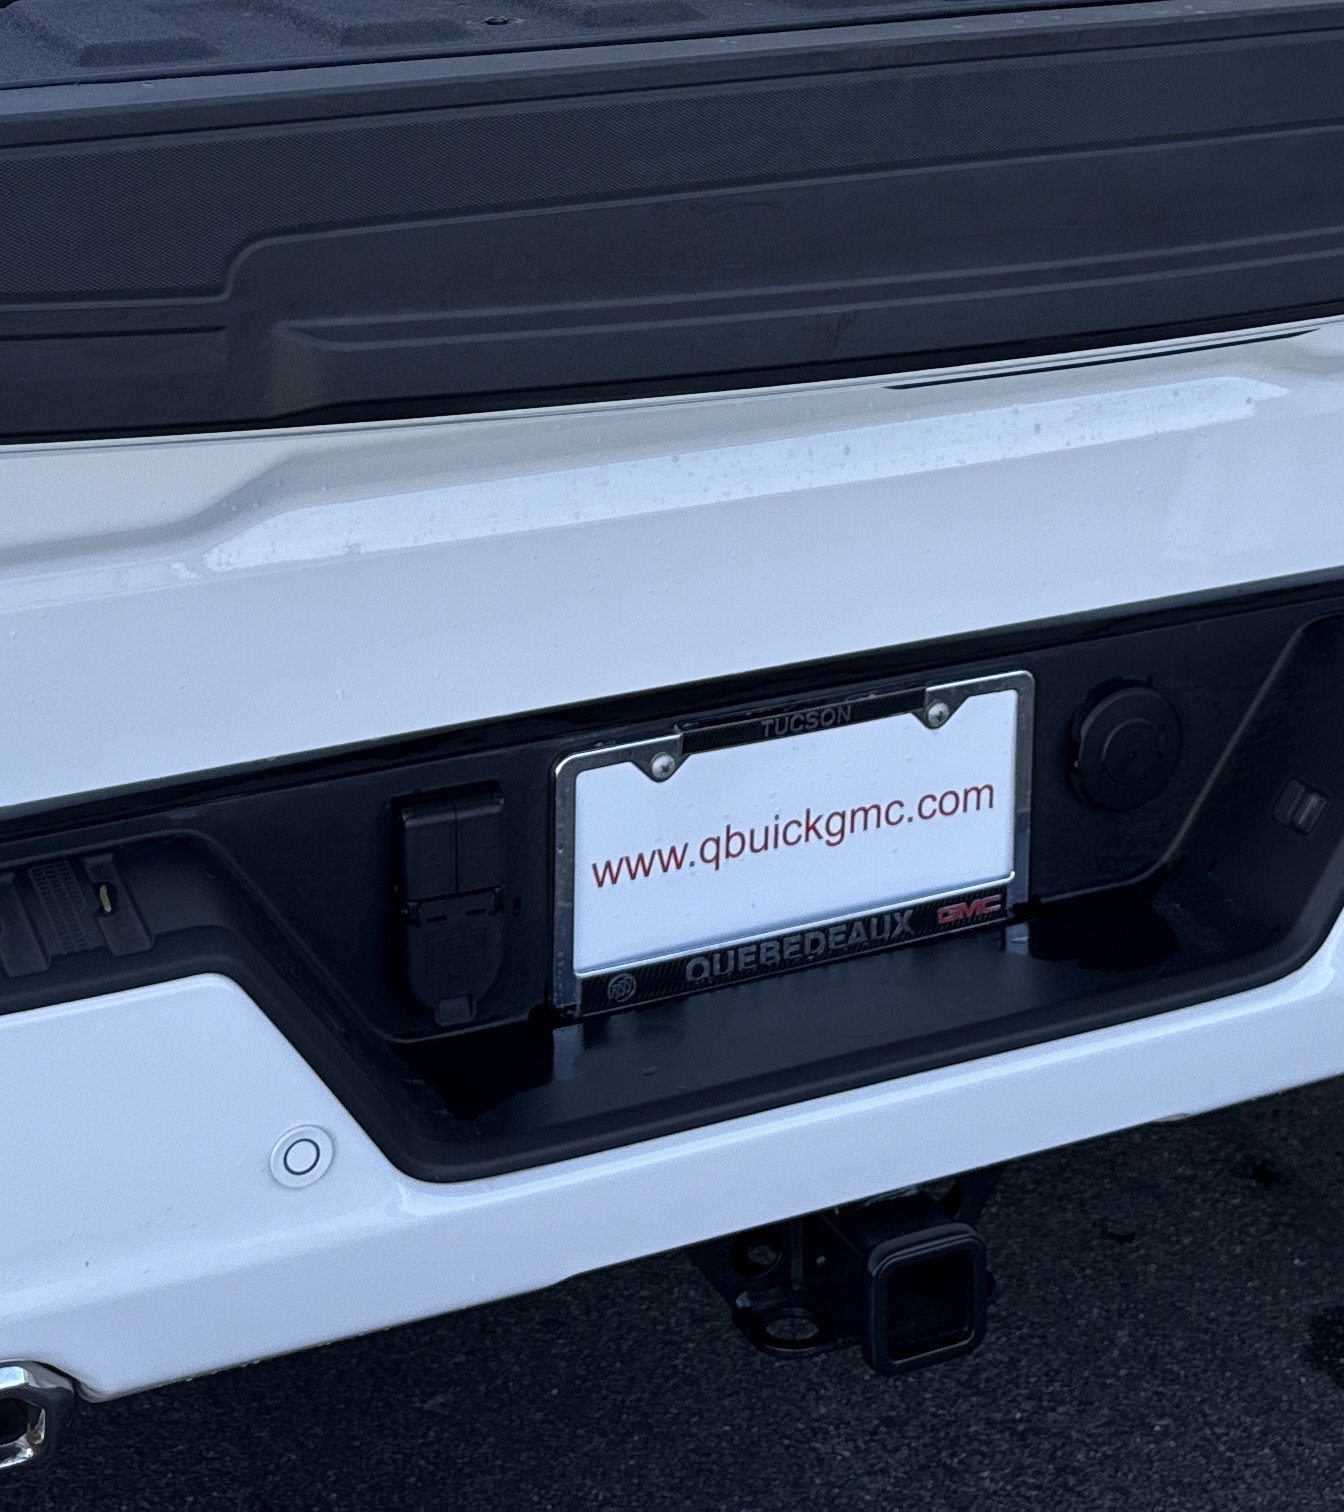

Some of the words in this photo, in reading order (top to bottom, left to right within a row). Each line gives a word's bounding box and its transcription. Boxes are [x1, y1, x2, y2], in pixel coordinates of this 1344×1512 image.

[760, 703, 853, 738] TUCSON
[591, 782, 996, 889] www.qbuickgmc.com
[684, 908, 917, 985] QUEBEDEAUX
[936, 893, 1003, 926] GMC
